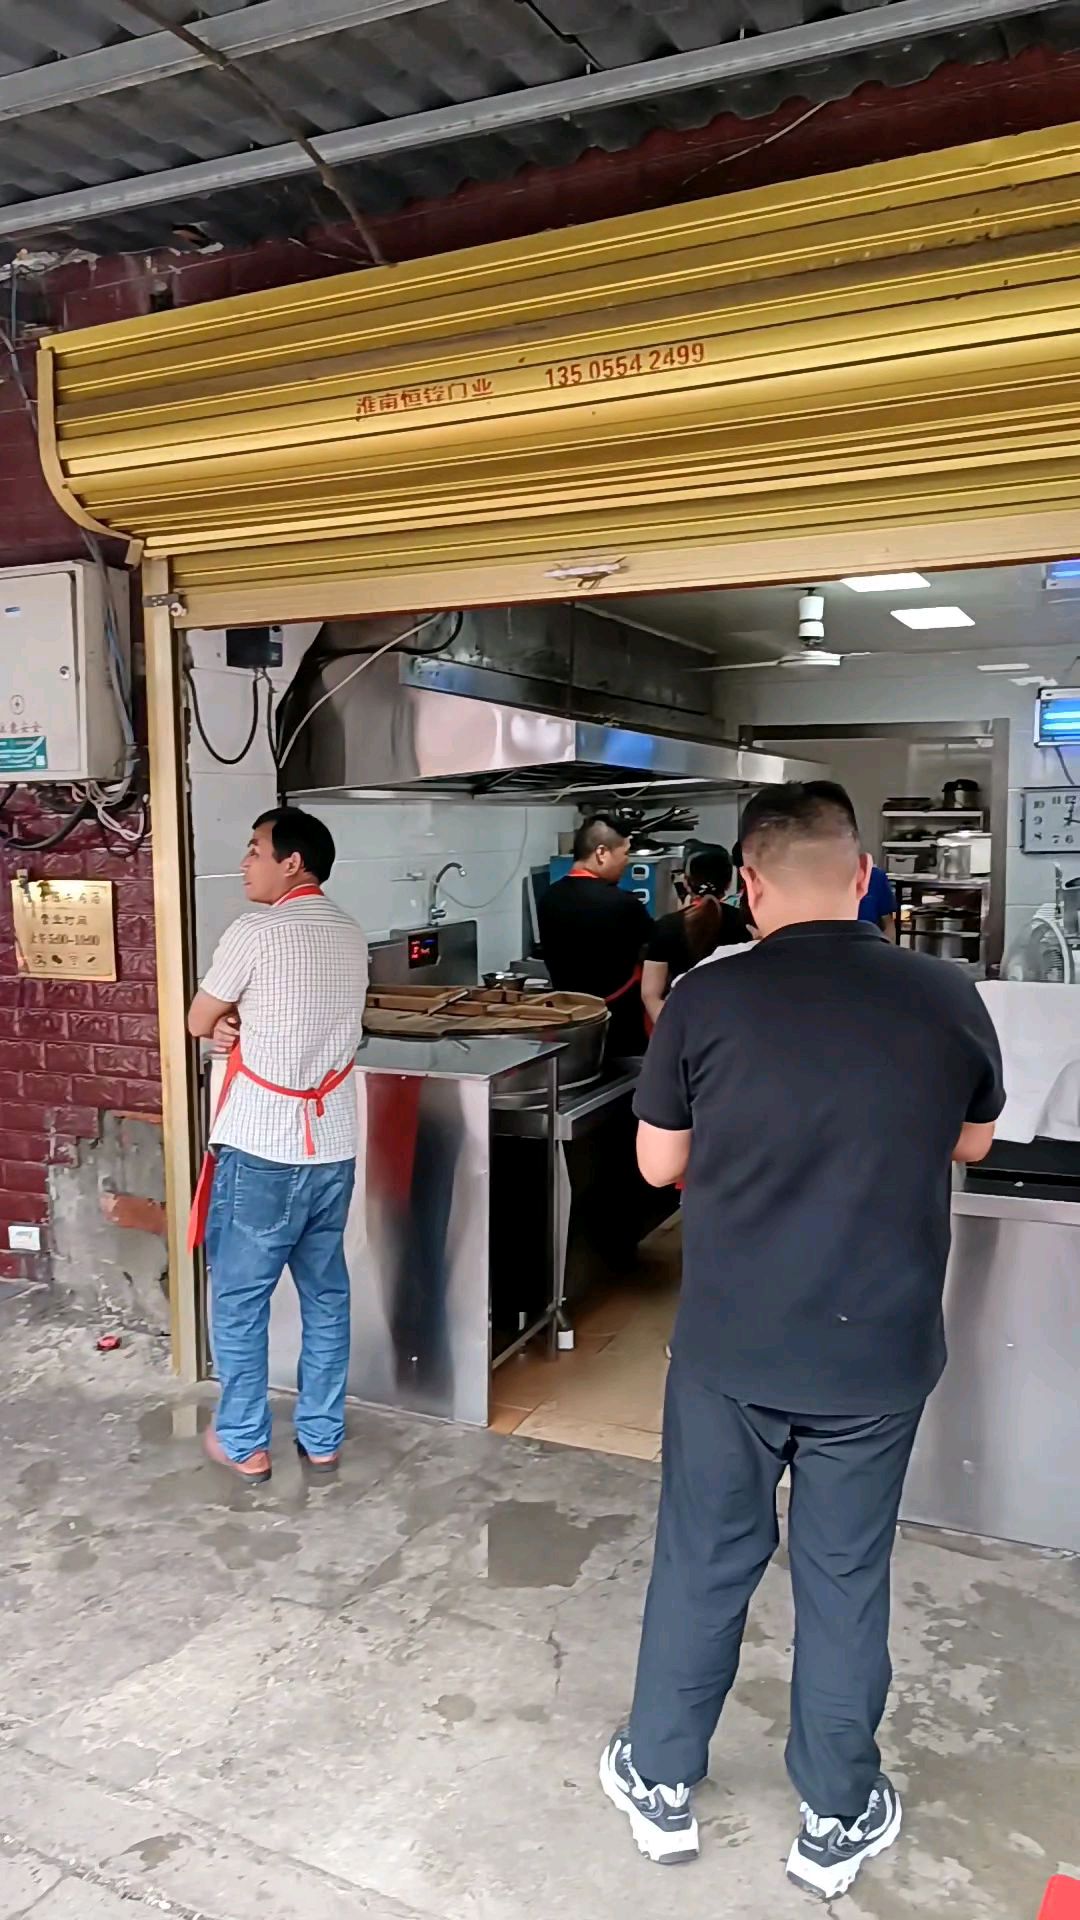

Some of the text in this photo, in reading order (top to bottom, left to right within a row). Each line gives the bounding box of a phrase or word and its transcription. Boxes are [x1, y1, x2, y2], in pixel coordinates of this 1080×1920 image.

[545, 342, 705, 387] 135 0554 2499
